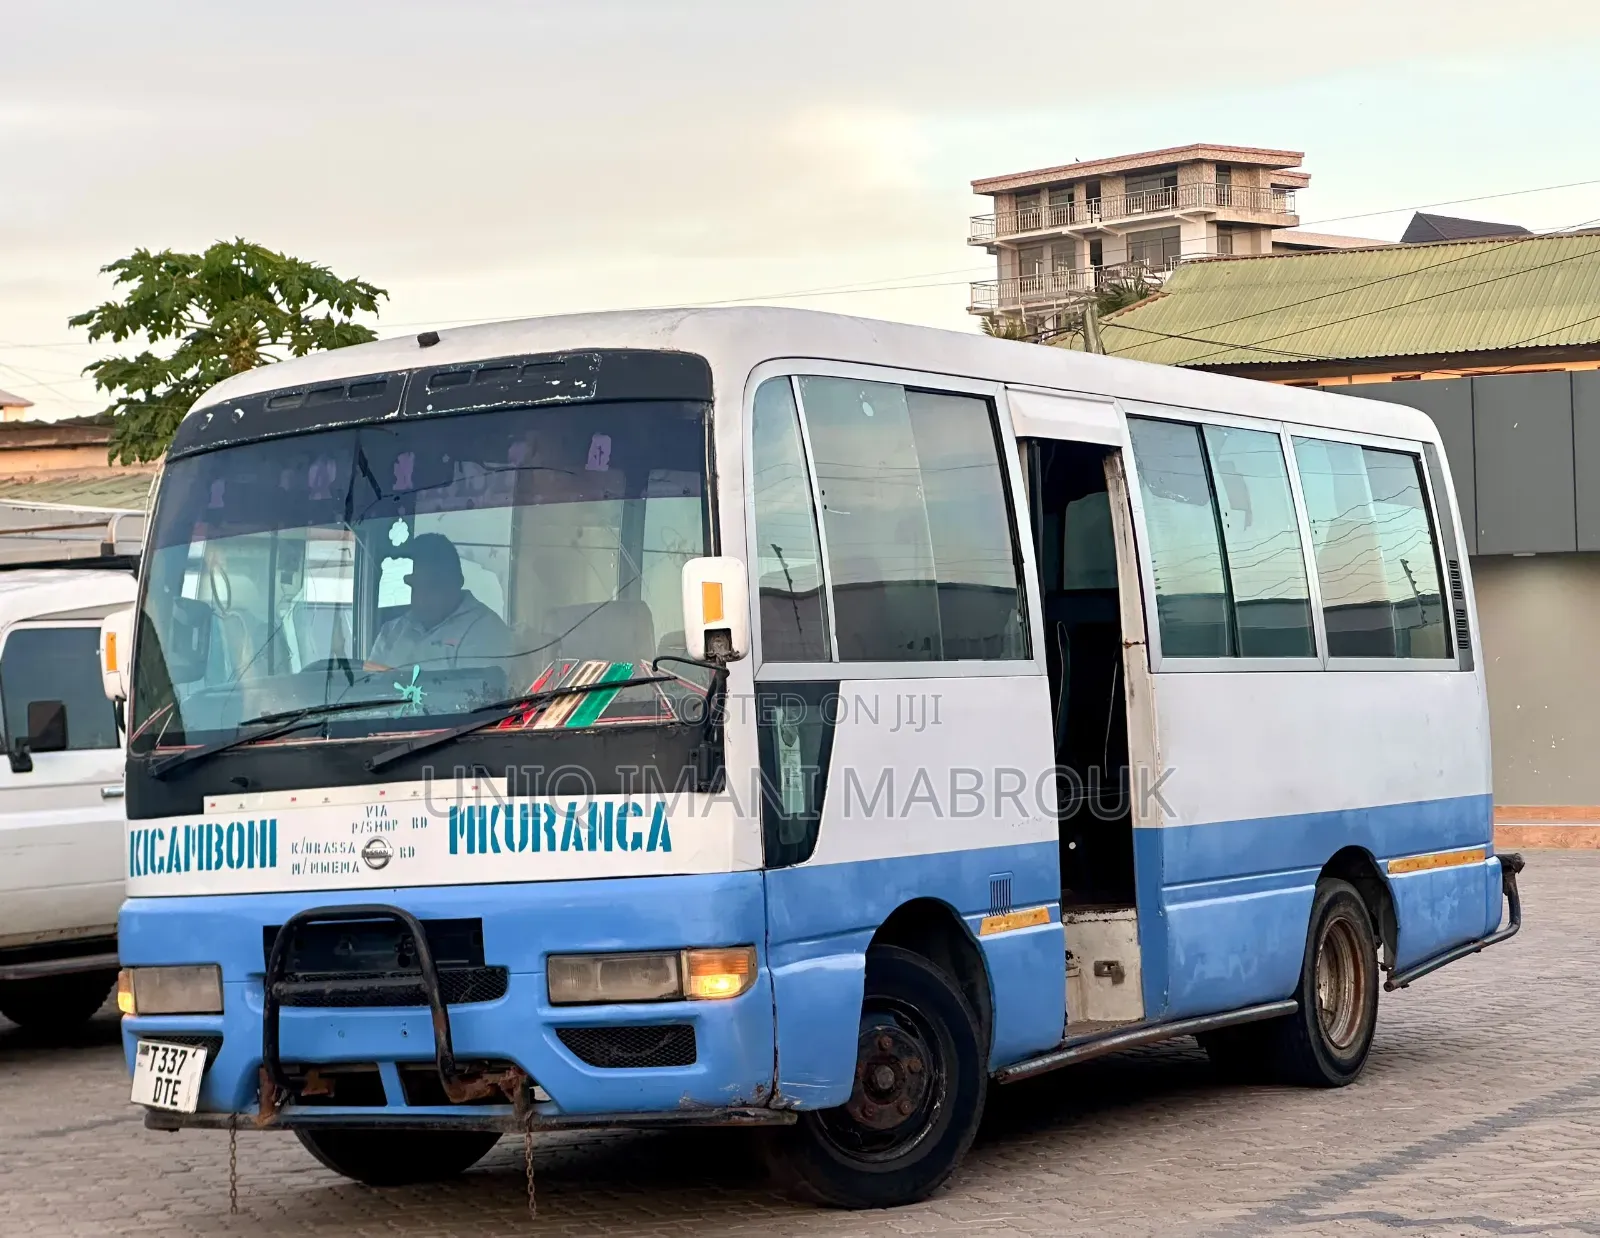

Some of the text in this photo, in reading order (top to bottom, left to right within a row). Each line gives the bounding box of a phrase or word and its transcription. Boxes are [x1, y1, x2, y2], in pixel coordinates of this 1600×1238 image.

[366, 804, 387, 818] VIA
[352, 816, 428, 834] P/SHOP RD
[448, 801, 672, 855] MKURANGA
[129, 818, 277, 877] KIGAMBONI
[399, 846, 415, 858] RD
[152, 1077, 181, 1106] DTE
